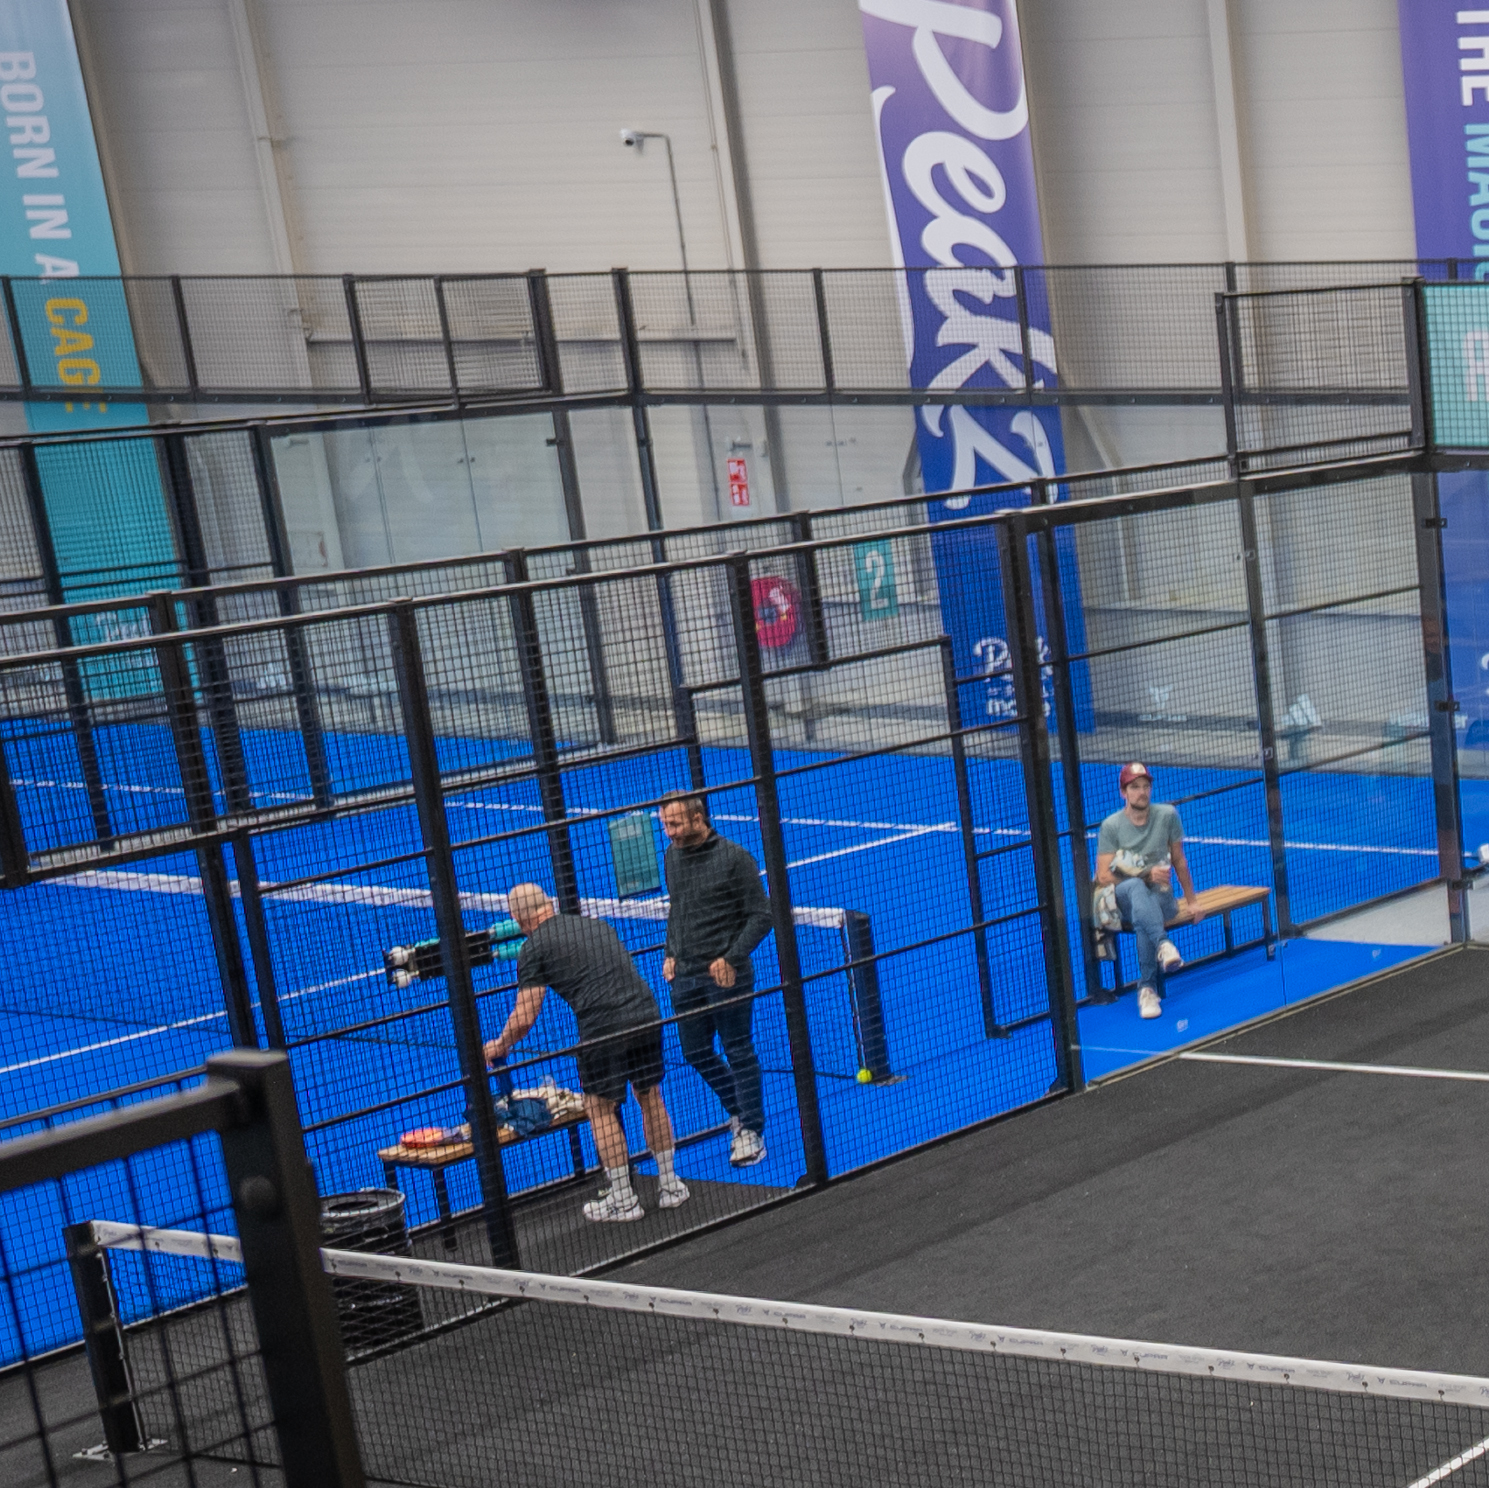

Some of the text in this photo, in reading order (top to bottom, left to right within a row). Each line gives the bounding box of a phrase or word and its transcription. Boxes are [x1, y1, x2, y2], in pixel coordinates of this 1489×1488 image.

[0, 51, 60, 178] BORN
[23, 194, 72, 239] IN
[34, 253, 80, 285] A
[860, 0, 1058, 508] Peakz
[865, 549, 890, 611] 2
